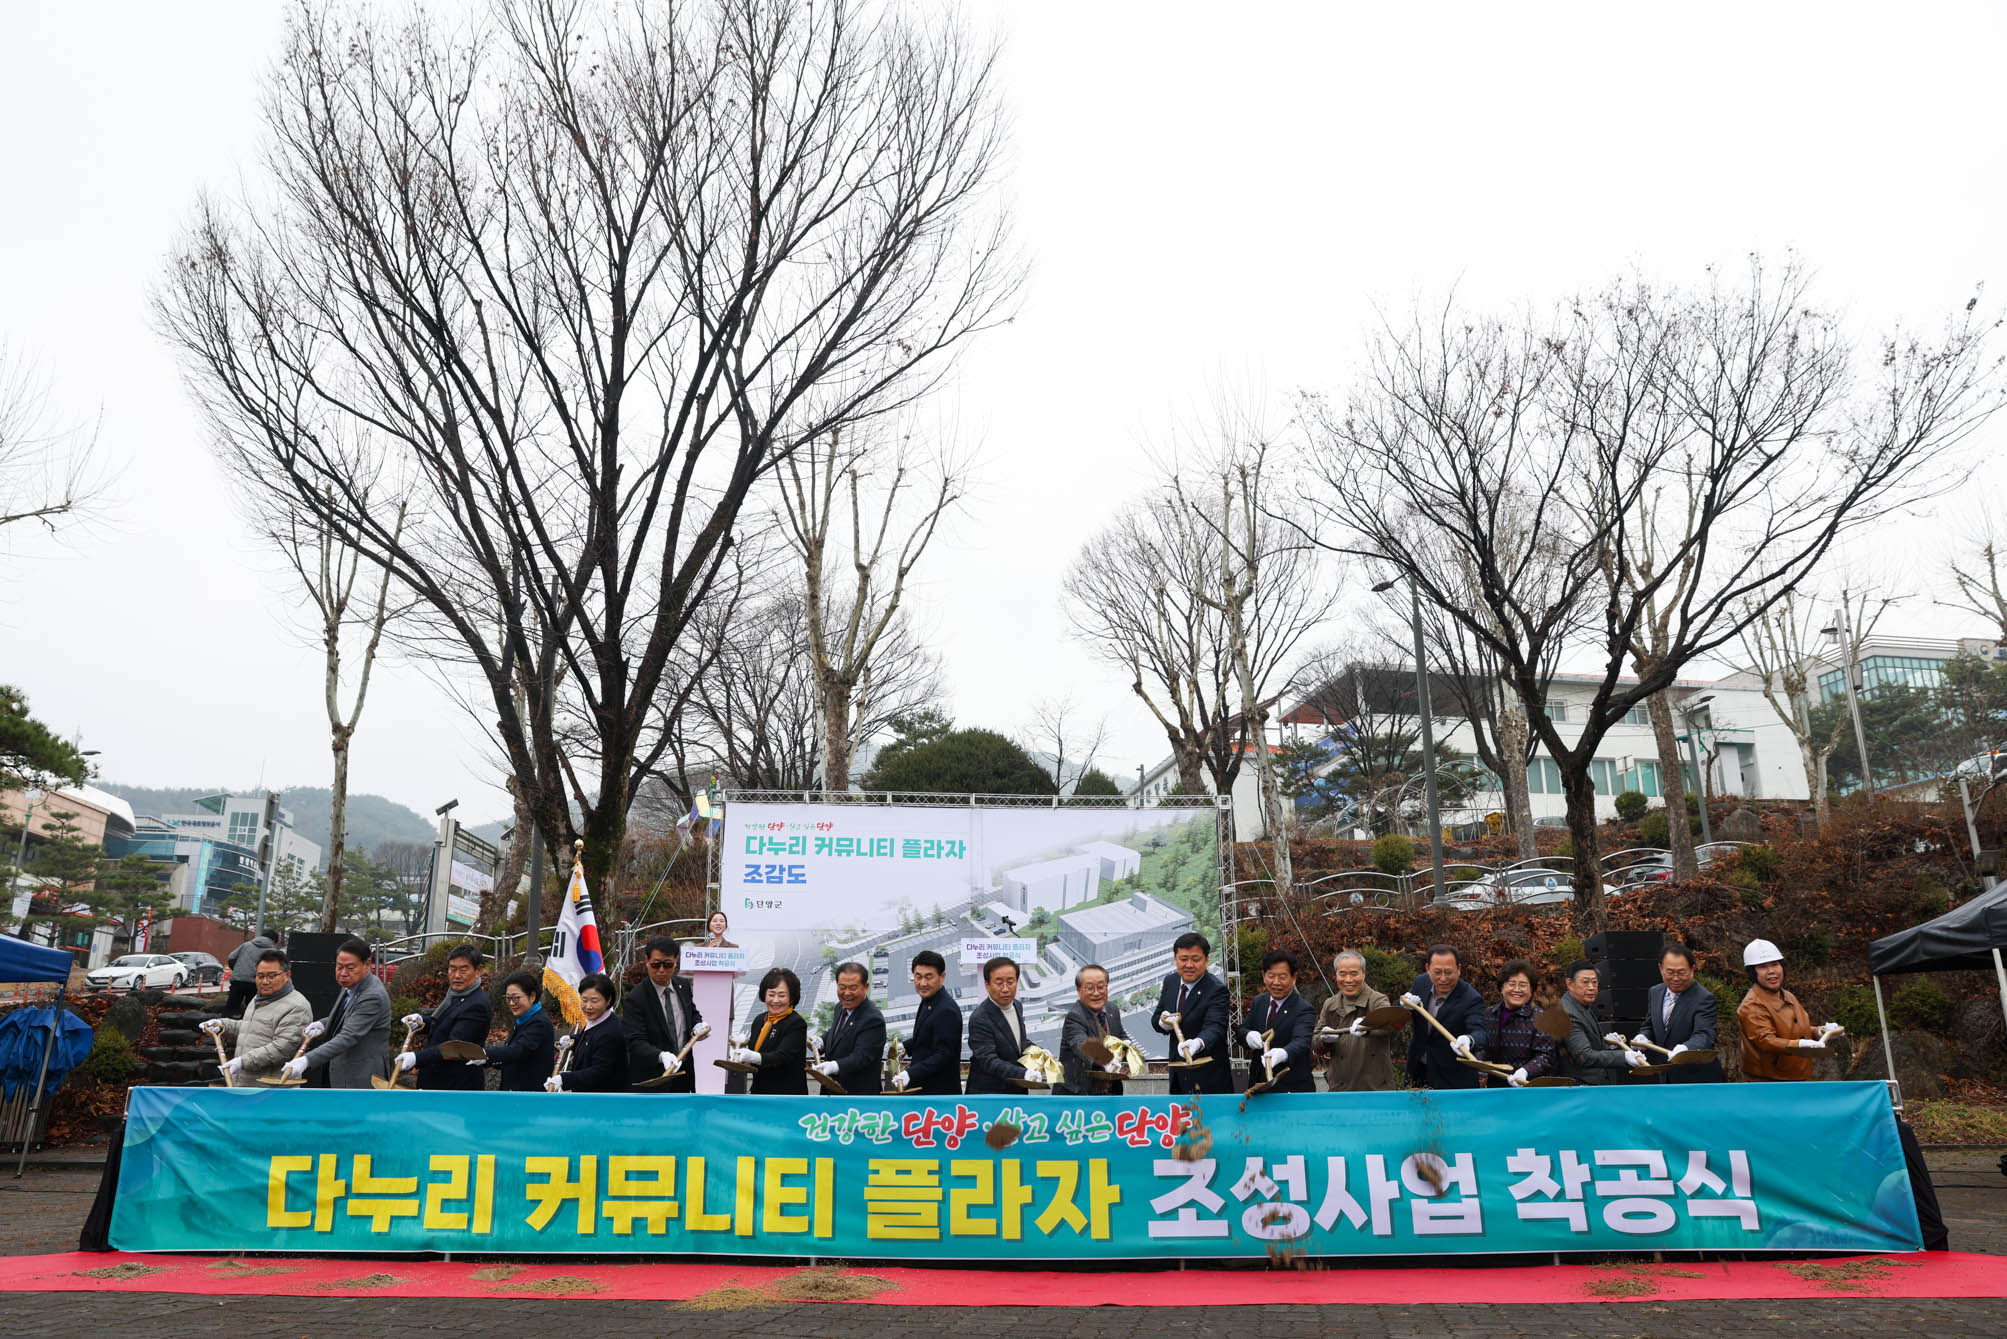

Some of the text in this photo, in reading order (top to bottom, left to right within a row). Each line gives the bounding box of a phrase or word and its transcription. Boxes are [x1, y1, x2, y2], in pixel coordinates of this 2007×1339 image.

[767, 821, 785, 832] 단양
[816, 821, 834, 832] 단양
[745, 835, 967, 860] 다누리 커뮤니티 플라자
[743, 863, 807, 885] 조감도
[756, 900, 783, 909] 단양군
[685, 951, 703, 959] 다누리
[966, 943, 985, 951] 다누리
[799, 1108, 899, 1145] 건강한
[901, 1104, 979, 1149] 단양
[1056, 1109, 1113, 1145] 싶은
[1115, 1103, 1192, 1148] 단양
[266, 1148, 1760, 1240] 다누리 커뮤니티 플라자 조성사업 착공식
